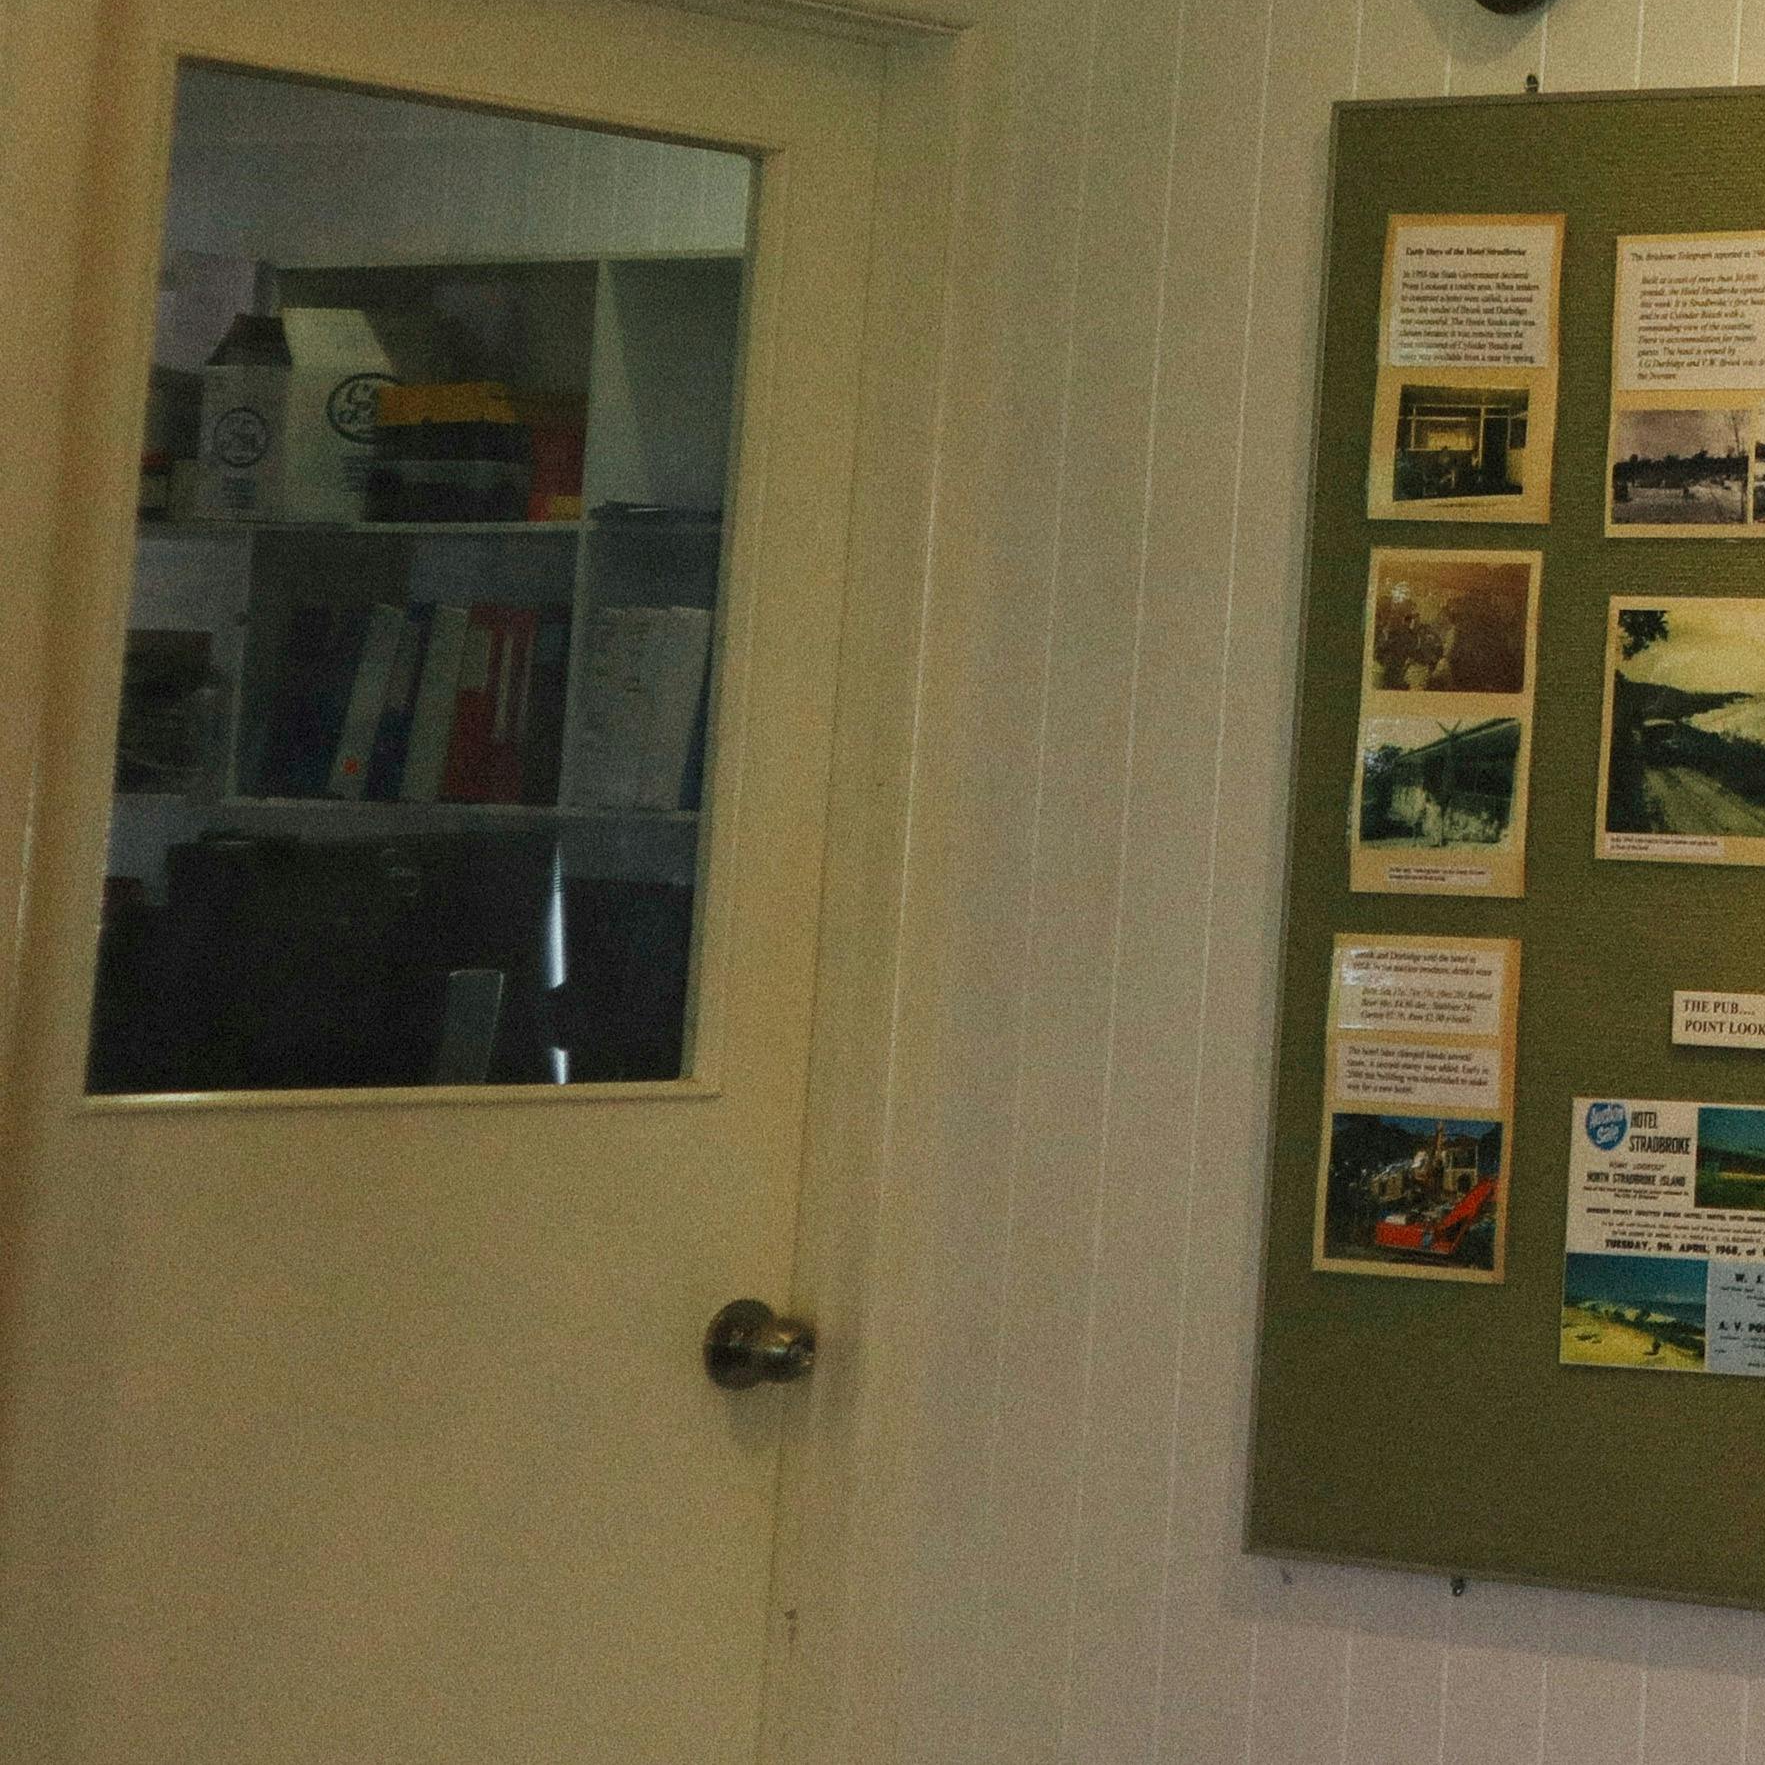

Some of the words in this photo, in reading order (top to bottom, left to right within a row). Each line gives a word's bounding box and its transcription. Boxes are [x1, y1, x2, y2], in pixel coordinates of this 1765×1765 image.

[1683, 999, 1709, 1012] THE
[1685, 1020, 1725, 1033] POINT
[1631, 1112, 1657, 1129] HOTEL
[1628, 1136, 1691, 1154] STRADBROKE
[1587, 1172, 1609, 1183] NORTH
[1613, 1172, 1656, 1185] STRADBROKE
[1661, 1175, 1685, 1187] ISLAND
[1605, 1239, 1652, 1251] TUESDAY,
